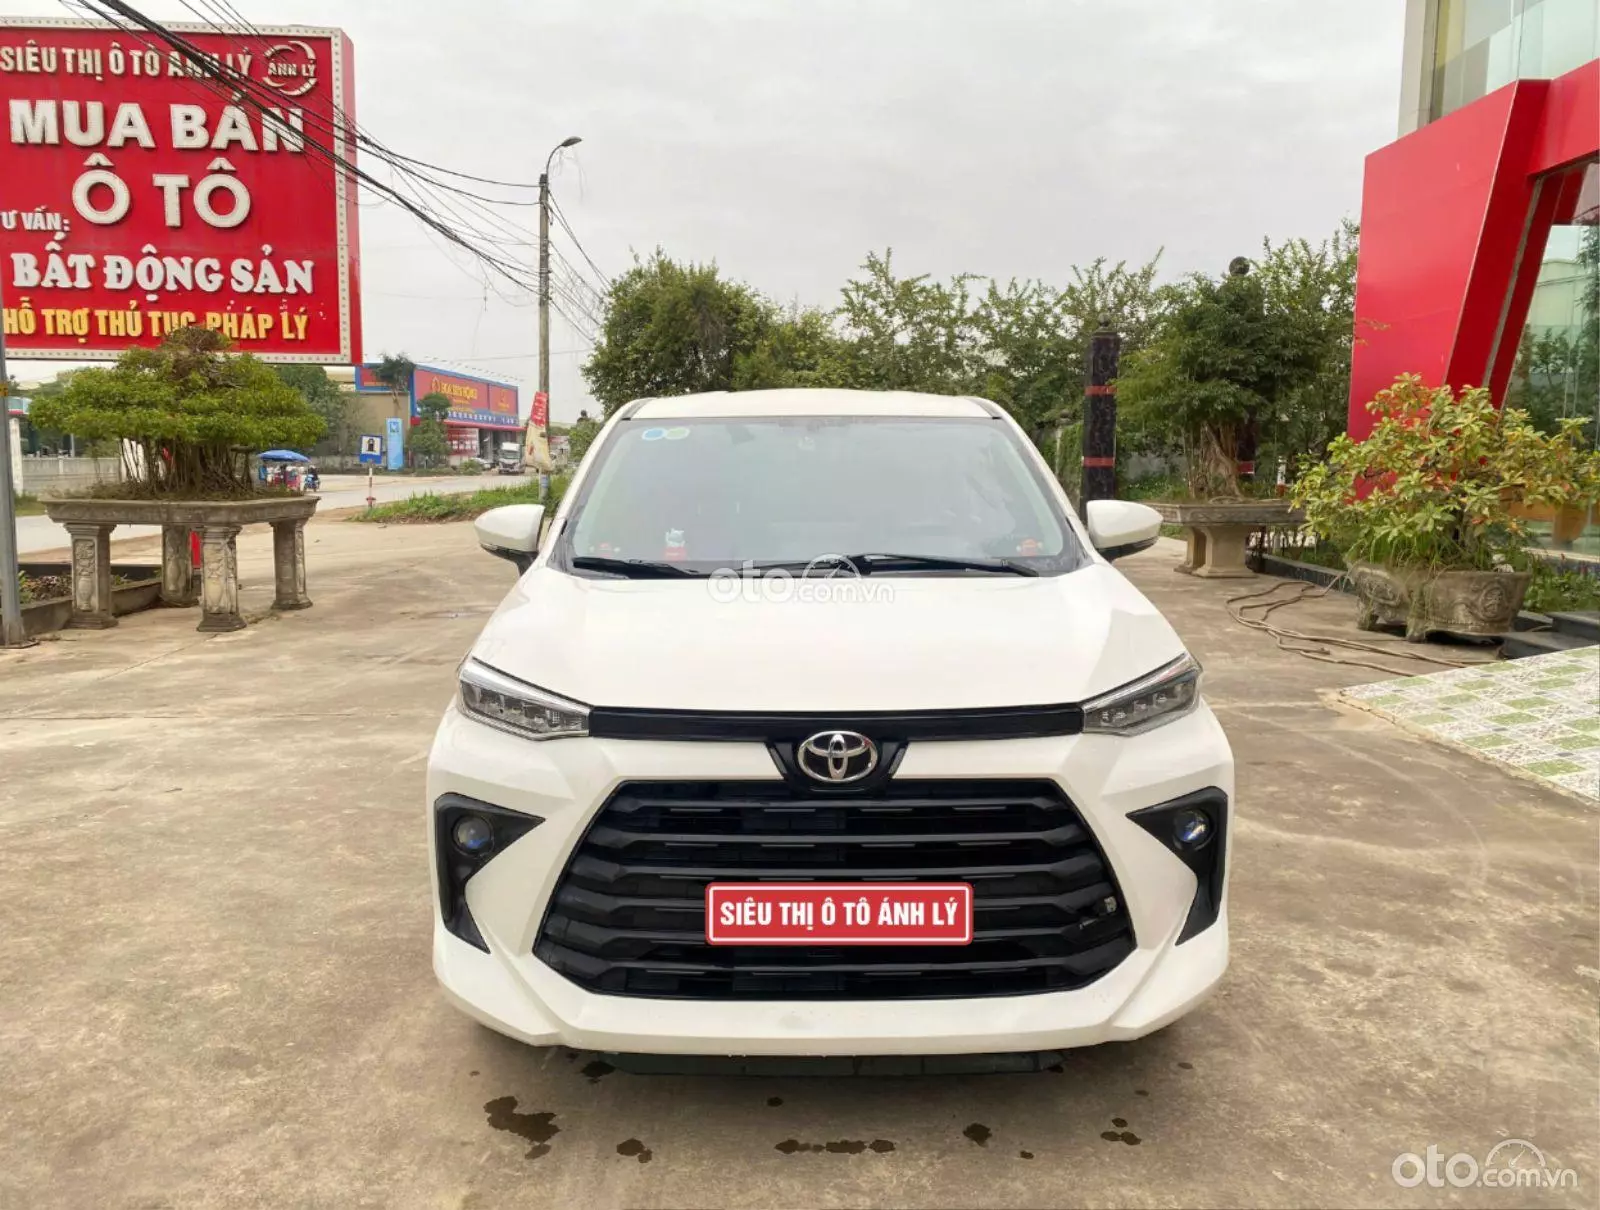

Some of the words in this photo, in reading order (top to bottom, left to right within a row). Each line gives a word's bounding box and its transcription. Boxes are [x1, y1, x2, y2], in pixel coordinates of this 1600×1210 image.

[0, 39, 57, 72] SIÊU
[61, 47, 103, 81] THỊ
[109, 41, 125, 75] Ô
[129, 43, 160, 77] TÔ
[301, 60, 316, 77] LÝ
[9, 99, 155, 149] MUA
[72, 152, 131, 225] Ô
[152, 157, 251, 228] TÔ
[11, 232, 96, 289] BẤT
[103, 244, 224, 301] ĐỘNG
[230, 244, 314, 294] SẢN
[2, 296, 36, 335] HỖ
[41, 307, 90, 343] TRỢ
[94, 300, 143, 337] THỦ
[205, 306, 273, 339] PHÁP
[281, 306, 308, 340] LÝ
[720, 897, 772, 926] SIÊU
[779, 902, 814, 931] THỊ
[821, 897, 836, 926] Ô
[843, 897, 871, 926] TÔ
[877, 897, 925, 926] ÁNH
[932, 897, 958, 926] LÝ
